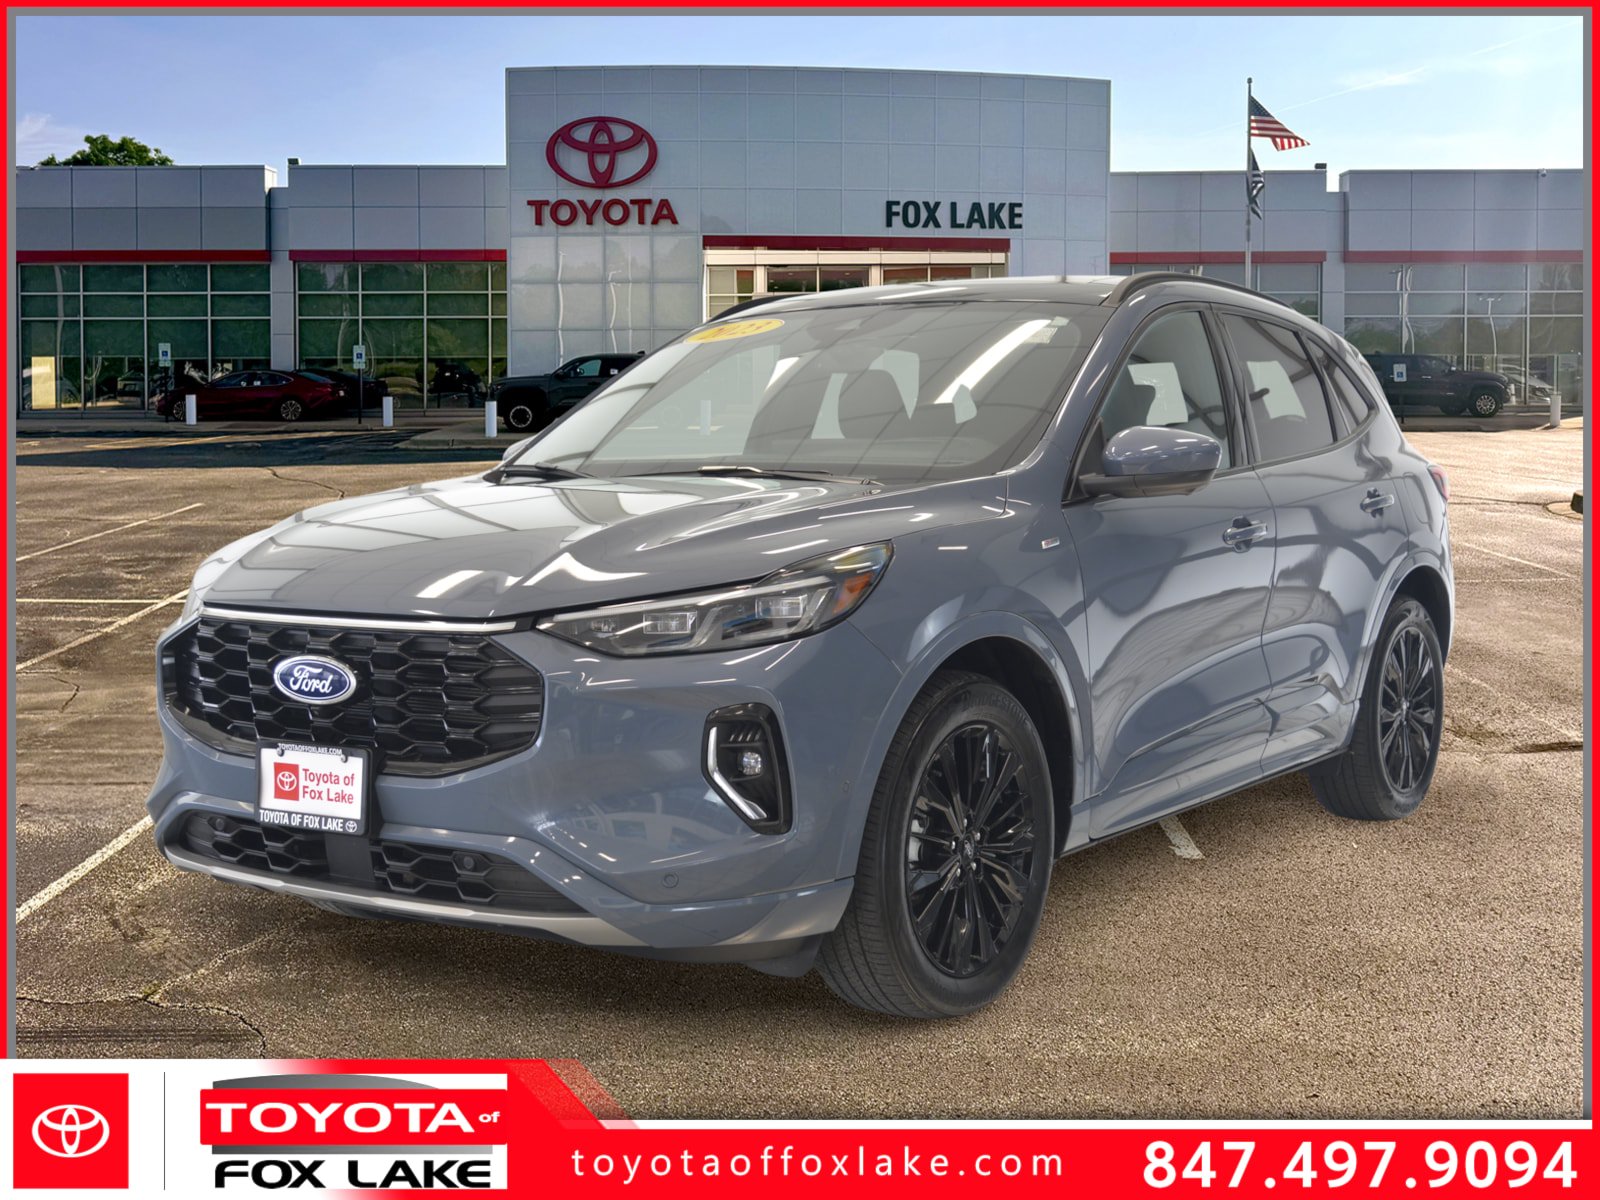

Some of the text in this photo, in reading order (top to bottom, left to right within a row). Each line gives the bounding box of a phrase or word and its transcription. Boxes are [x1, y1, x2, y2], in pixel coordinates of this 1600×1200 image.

[527, 199, 678, 226] TOYOTA
[885, 200, 1024, 230] FOX LAKE
[290, 664, 333, 694] Ford
[302, 768, 355, 786] Toyota of
[302, 785, 354, 804] Fox Lake
[259, 810, 343, 831] TOYOTA OF FOX LAKE
